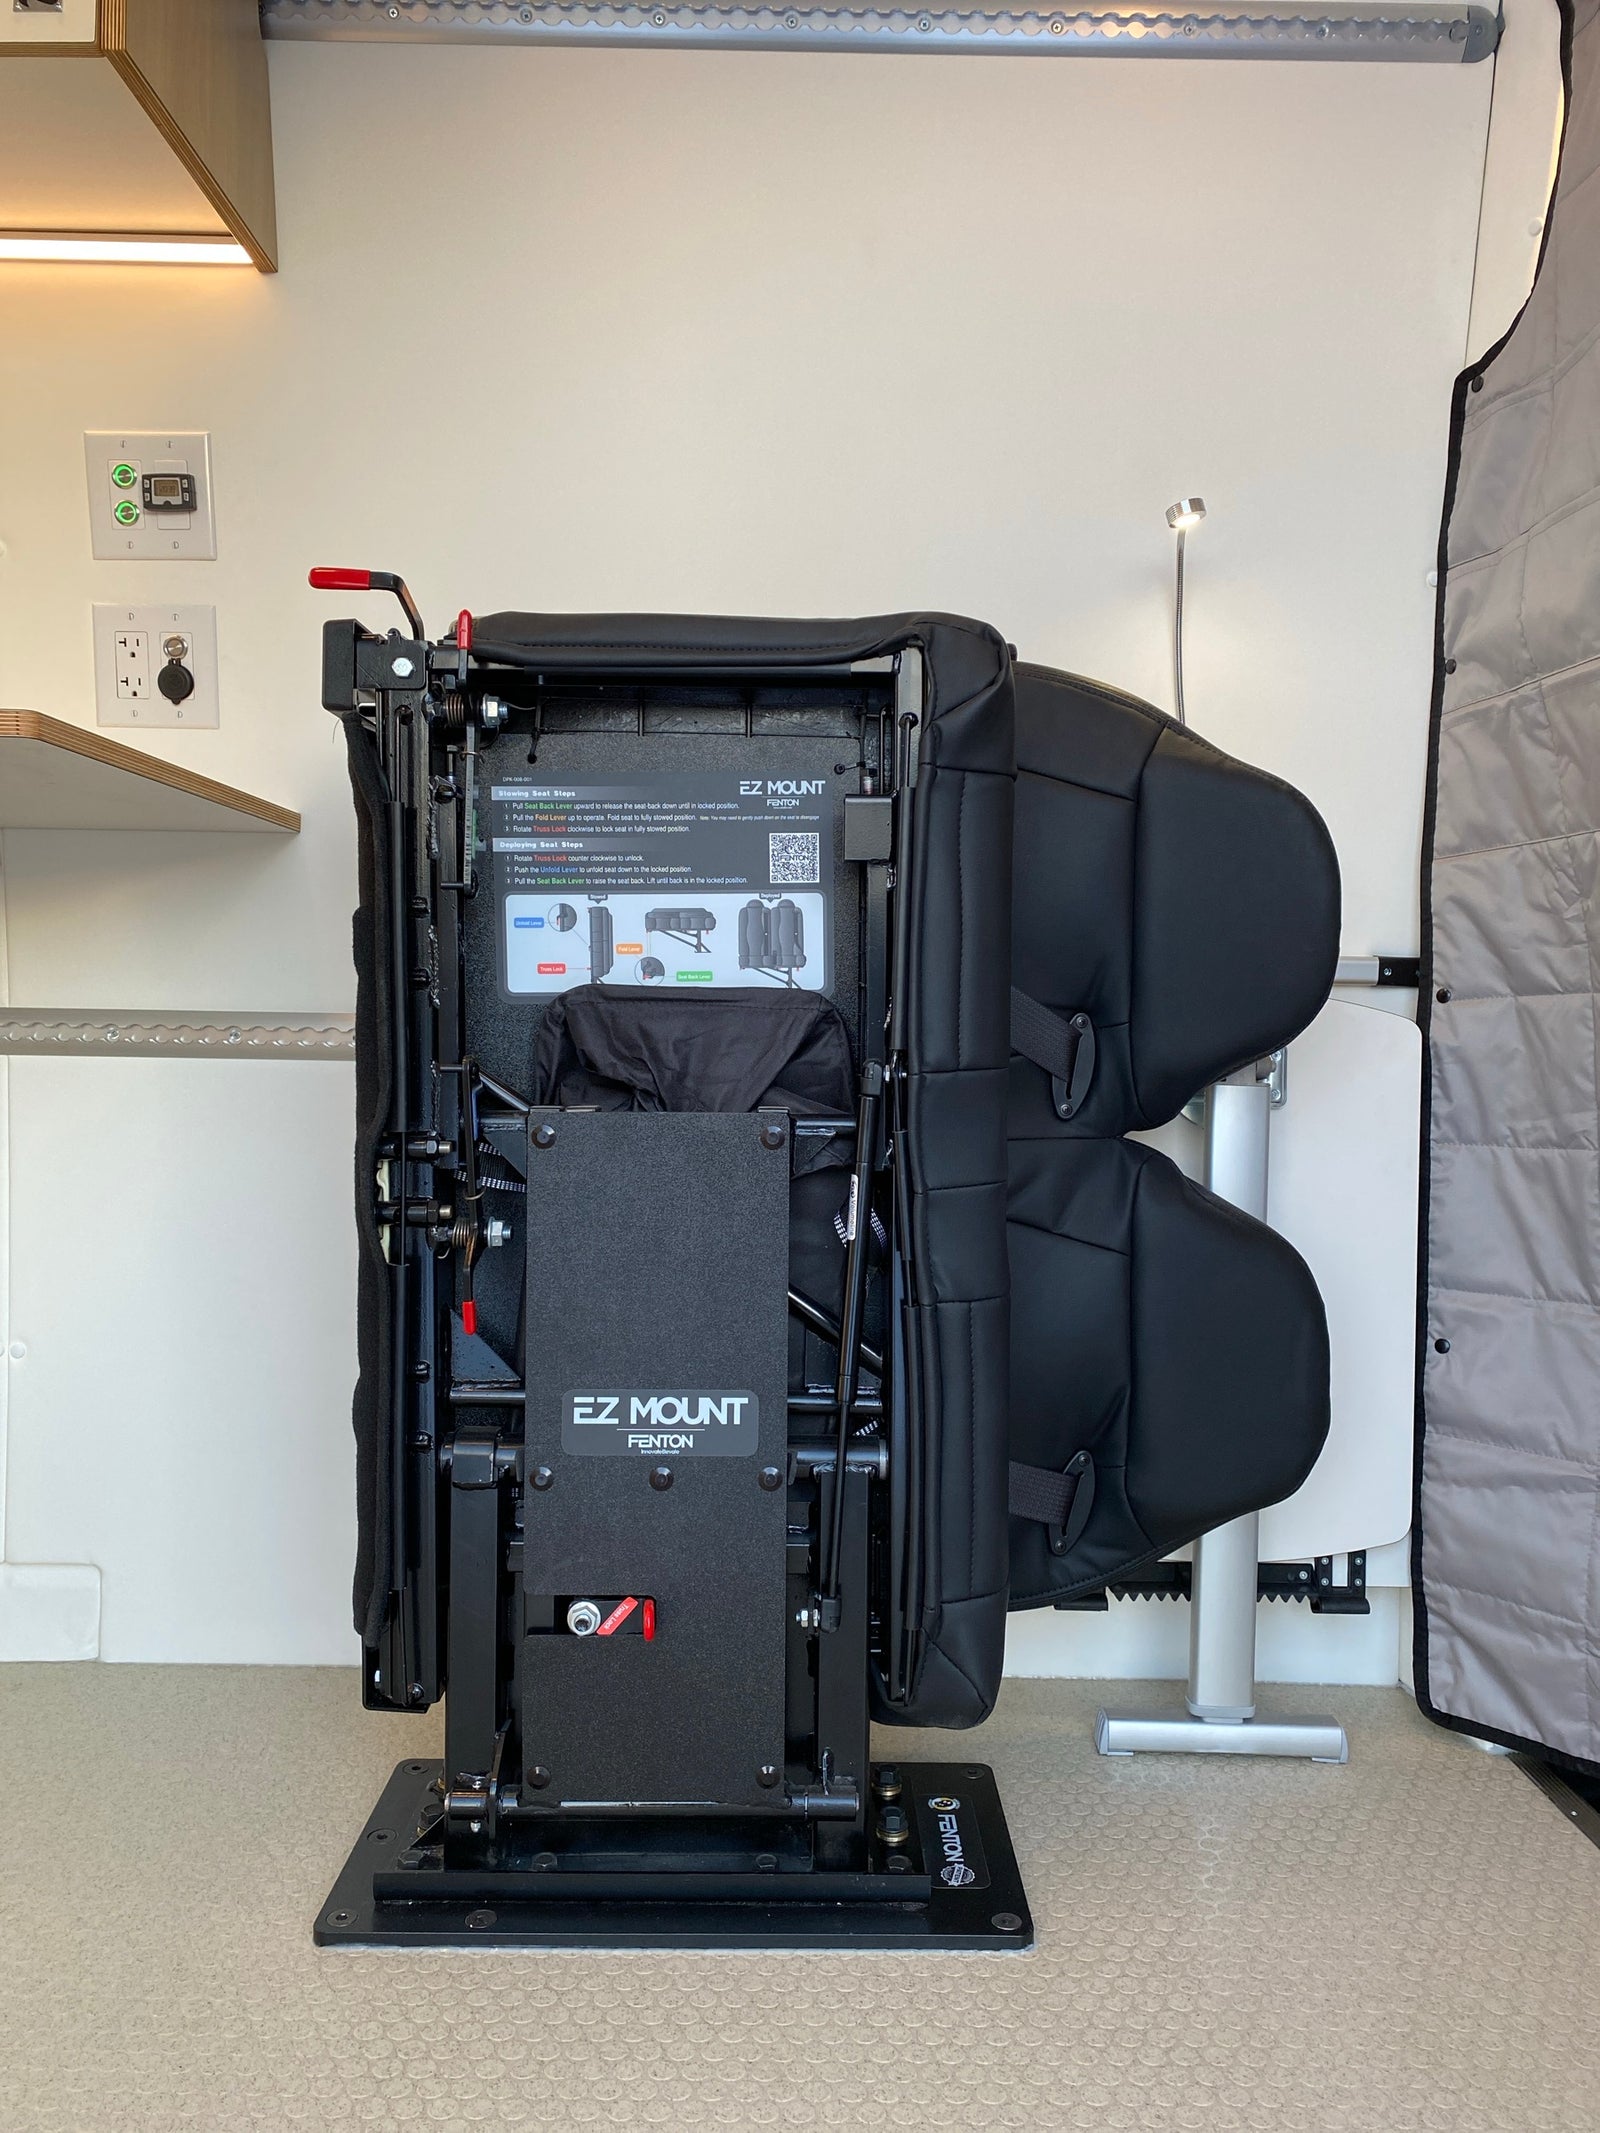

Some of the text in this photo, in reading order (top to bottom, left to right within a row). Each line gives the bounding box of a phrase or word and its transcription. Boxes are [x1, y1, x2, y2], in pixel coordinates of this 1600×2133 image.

[740, 780, 826, 795] EZ MOUNT
[573, 1396, 749, 1425] EZ MOUNT
[628, 1434, 693, 1448] FENTON
[604, 1604, 629, 1630] Truss Lock
[938, 1814, 964, 1862] FENTON
